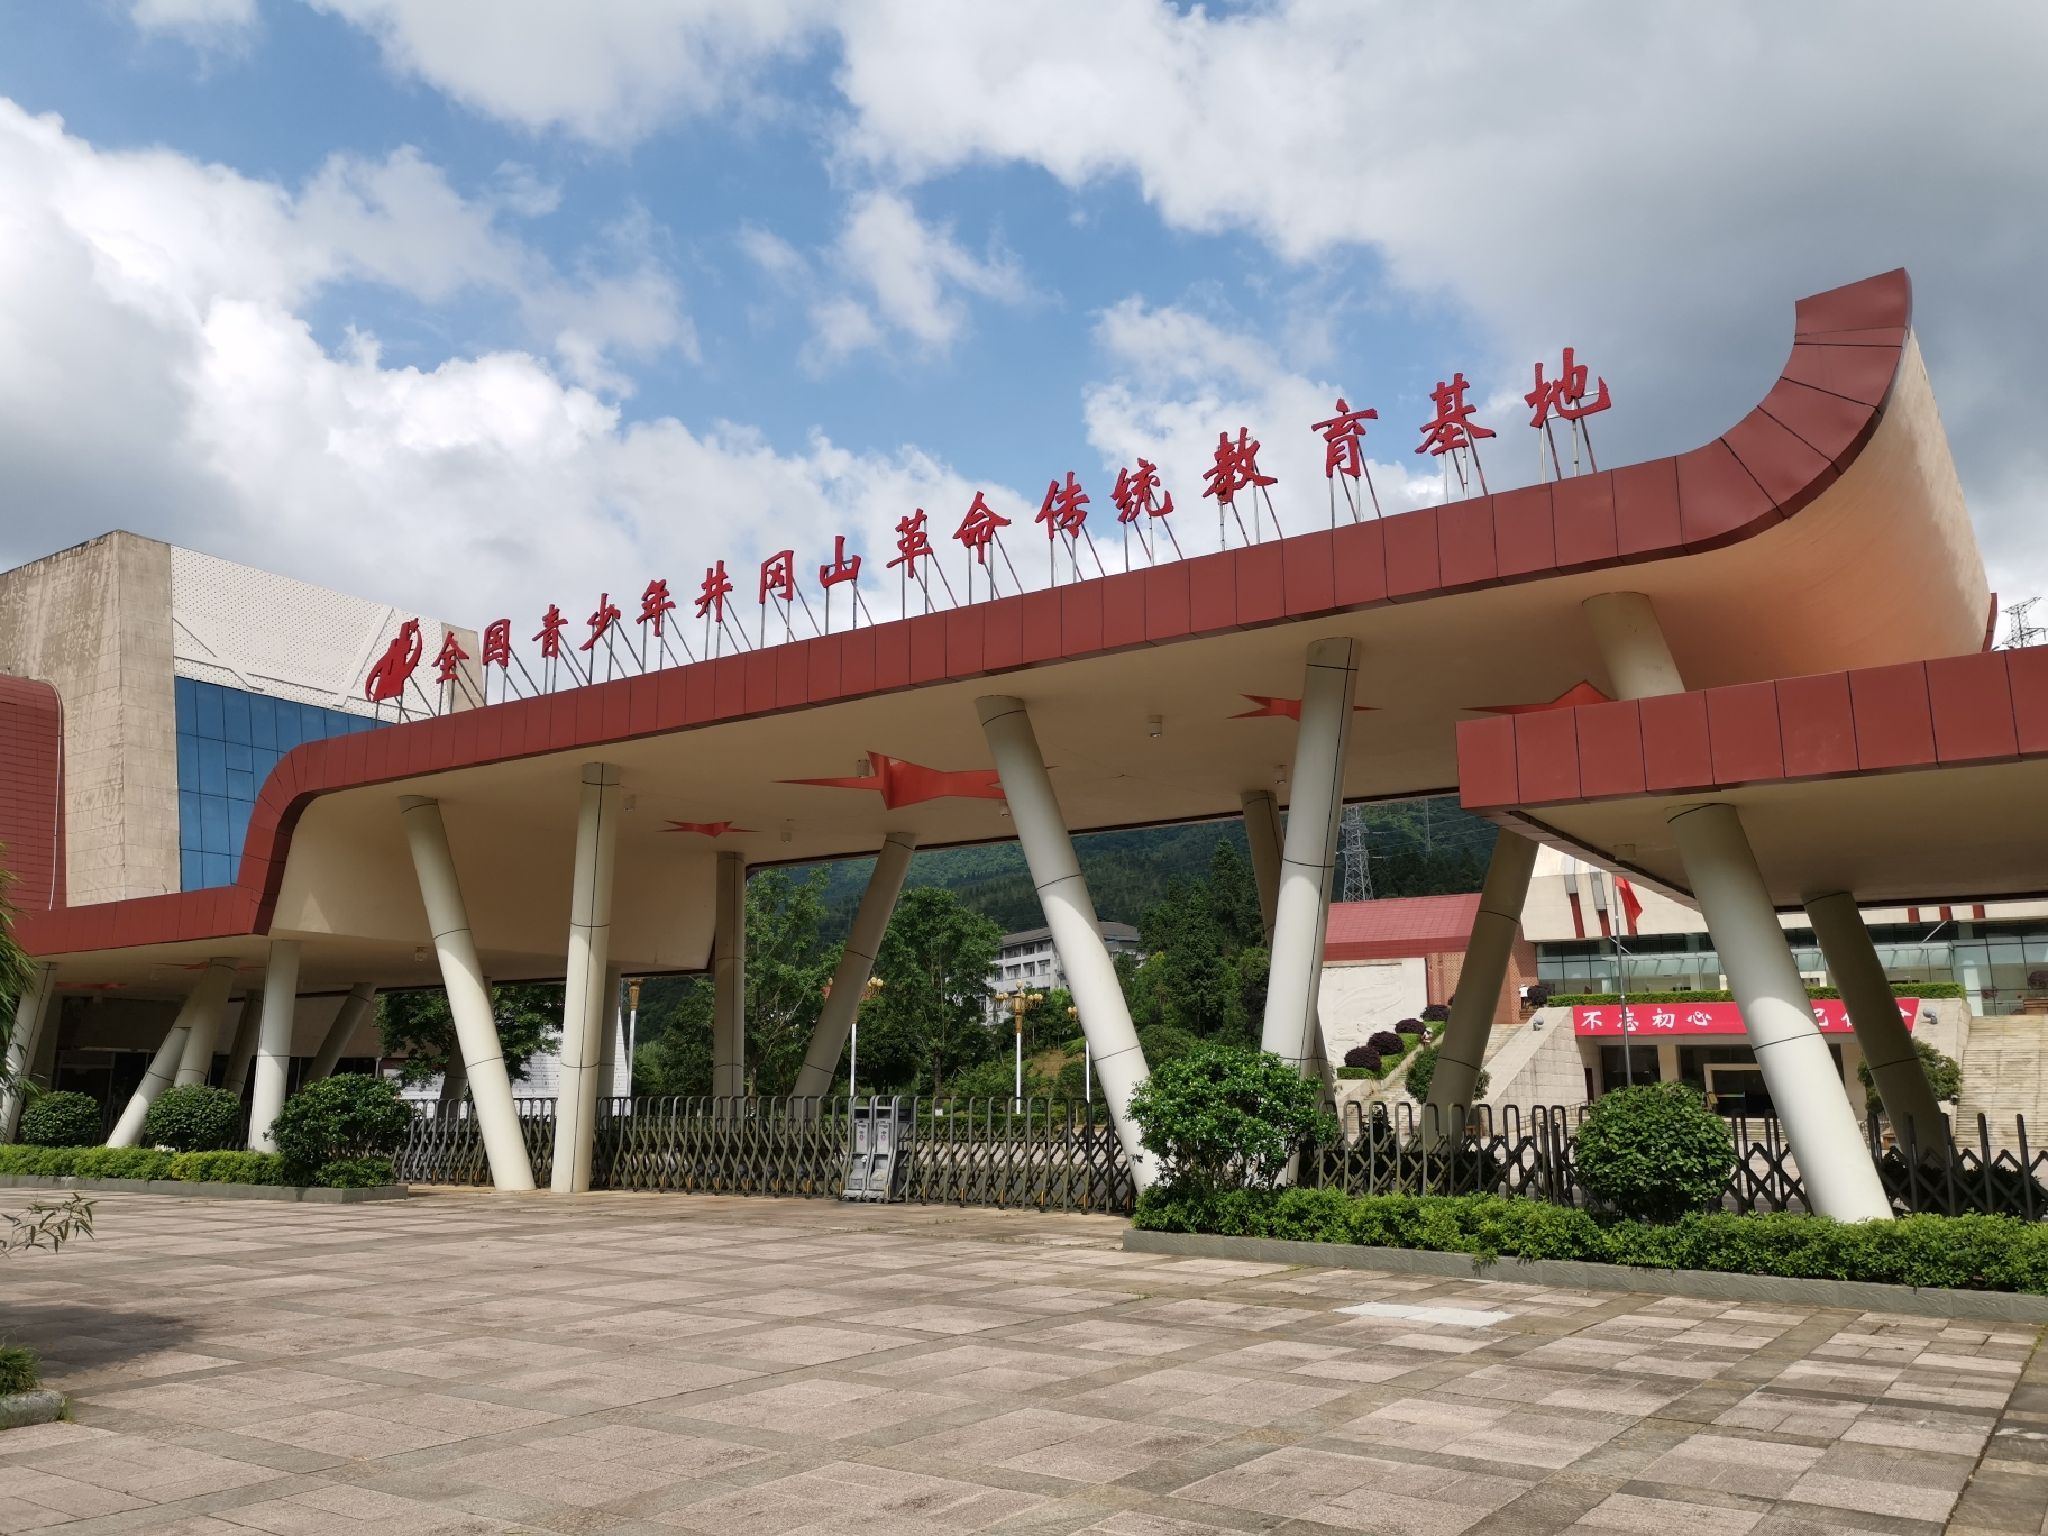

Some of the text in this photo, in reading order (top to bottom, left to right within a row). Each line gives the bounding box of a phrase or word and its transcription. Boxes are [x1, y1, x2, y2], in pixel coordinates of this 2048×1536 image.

[431, 347, 1612, 684] 全国青少年井冈山革命传统教育基地
[1581, 1006, 1713, 1032] 不忘初心
